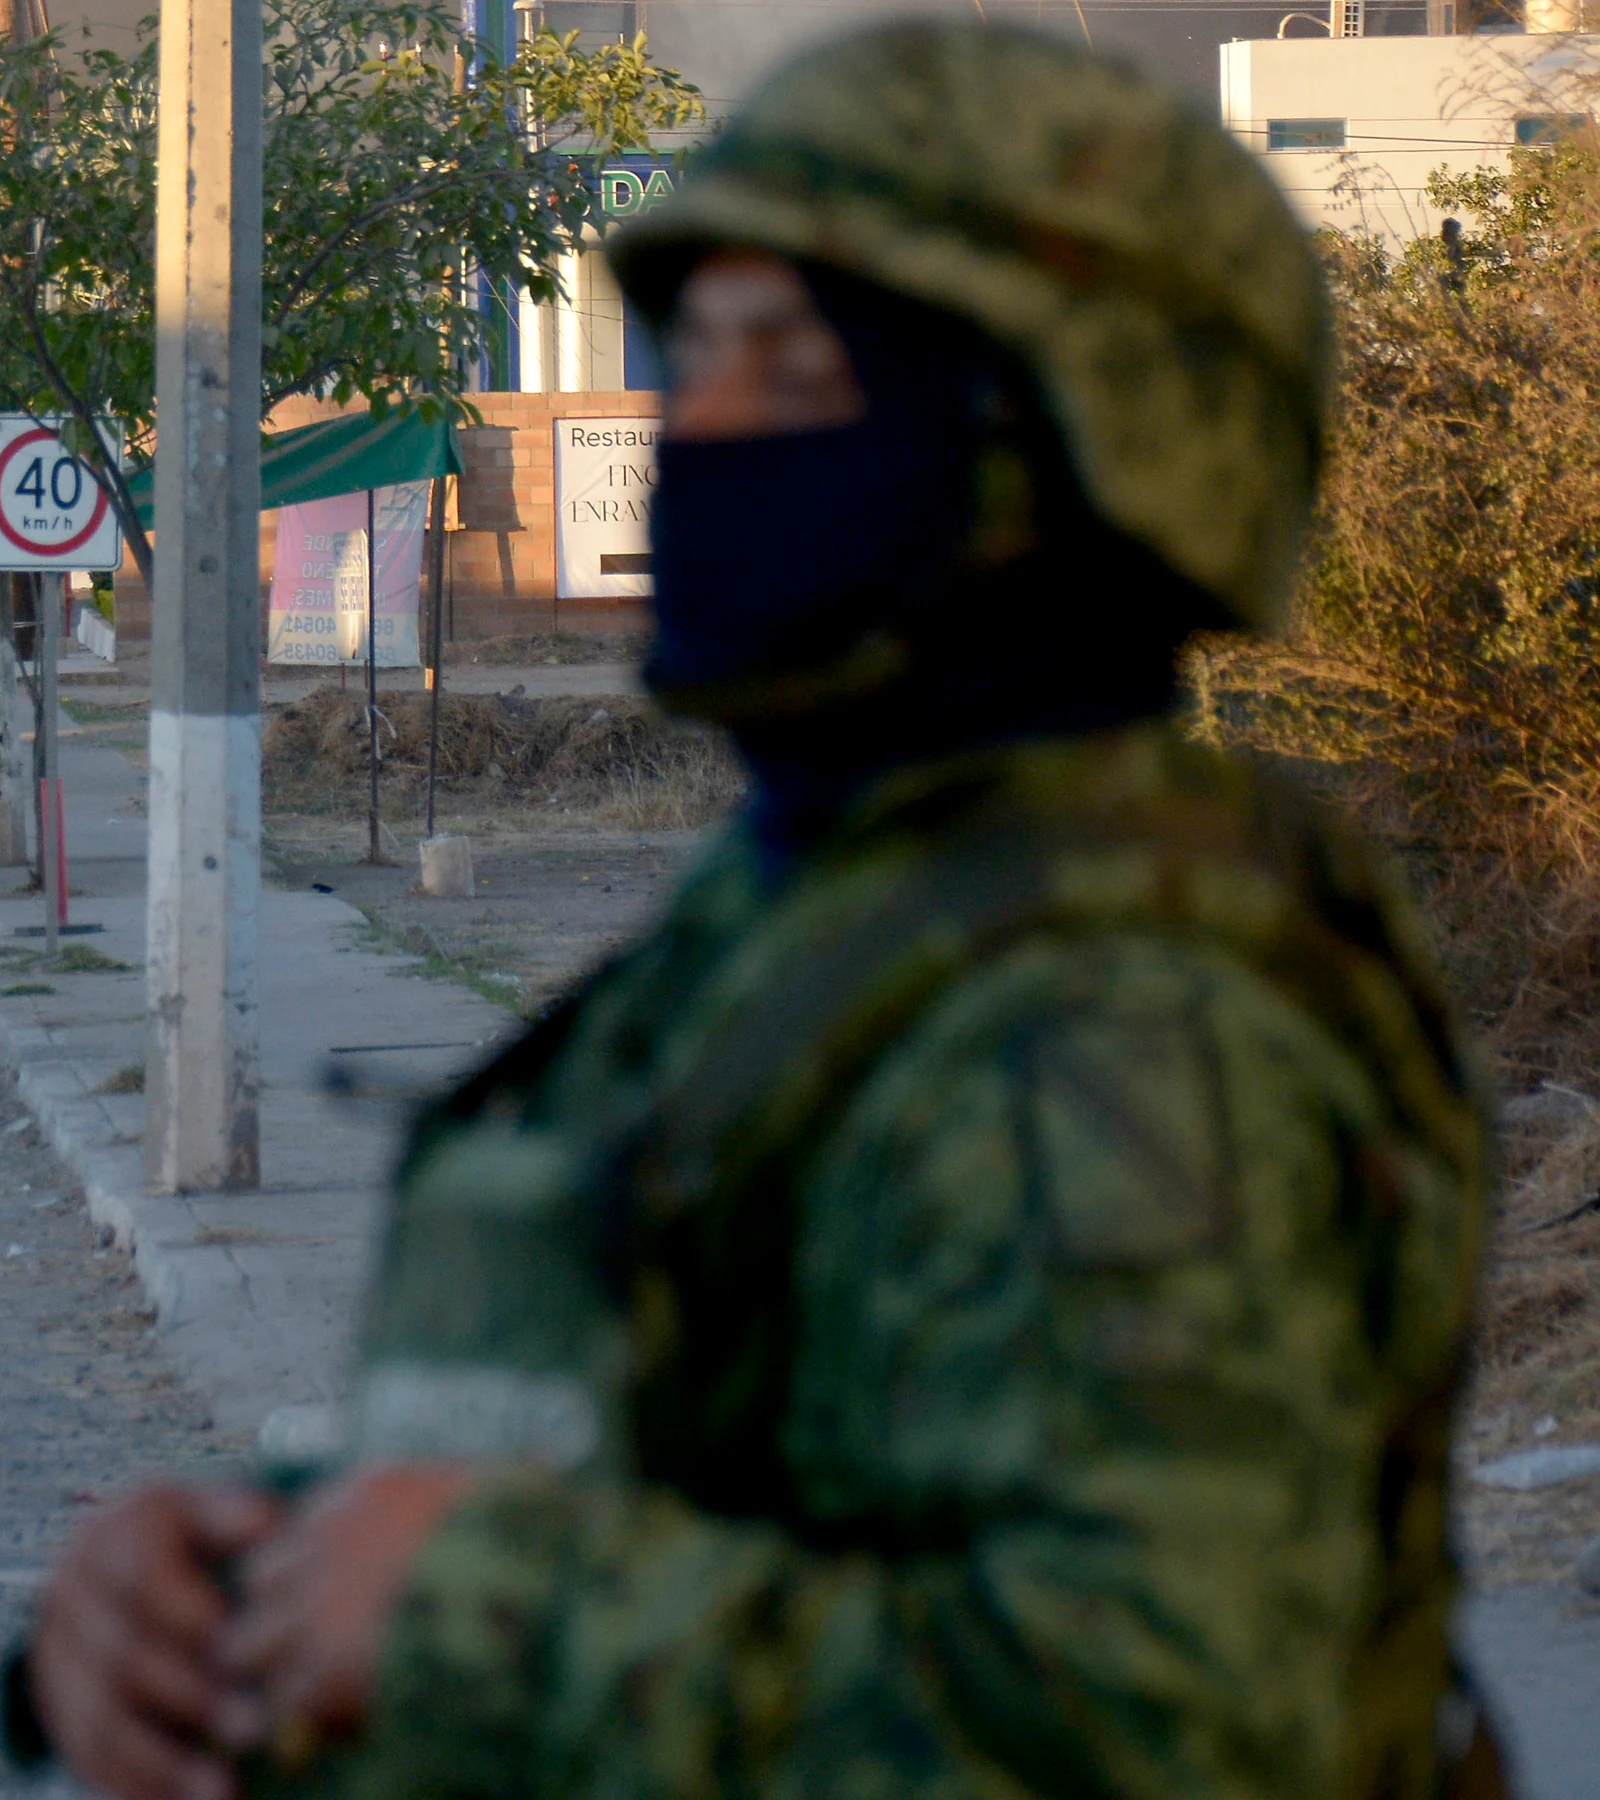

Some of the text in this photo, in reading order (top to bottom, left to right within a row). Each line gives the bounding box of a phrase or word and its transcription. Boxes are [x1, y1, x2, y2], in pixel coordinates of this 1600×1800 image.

[601, 169, 682, 216] DA
[15, 456, 82, 510] 40
[23, 516, 73, 530] km/h
